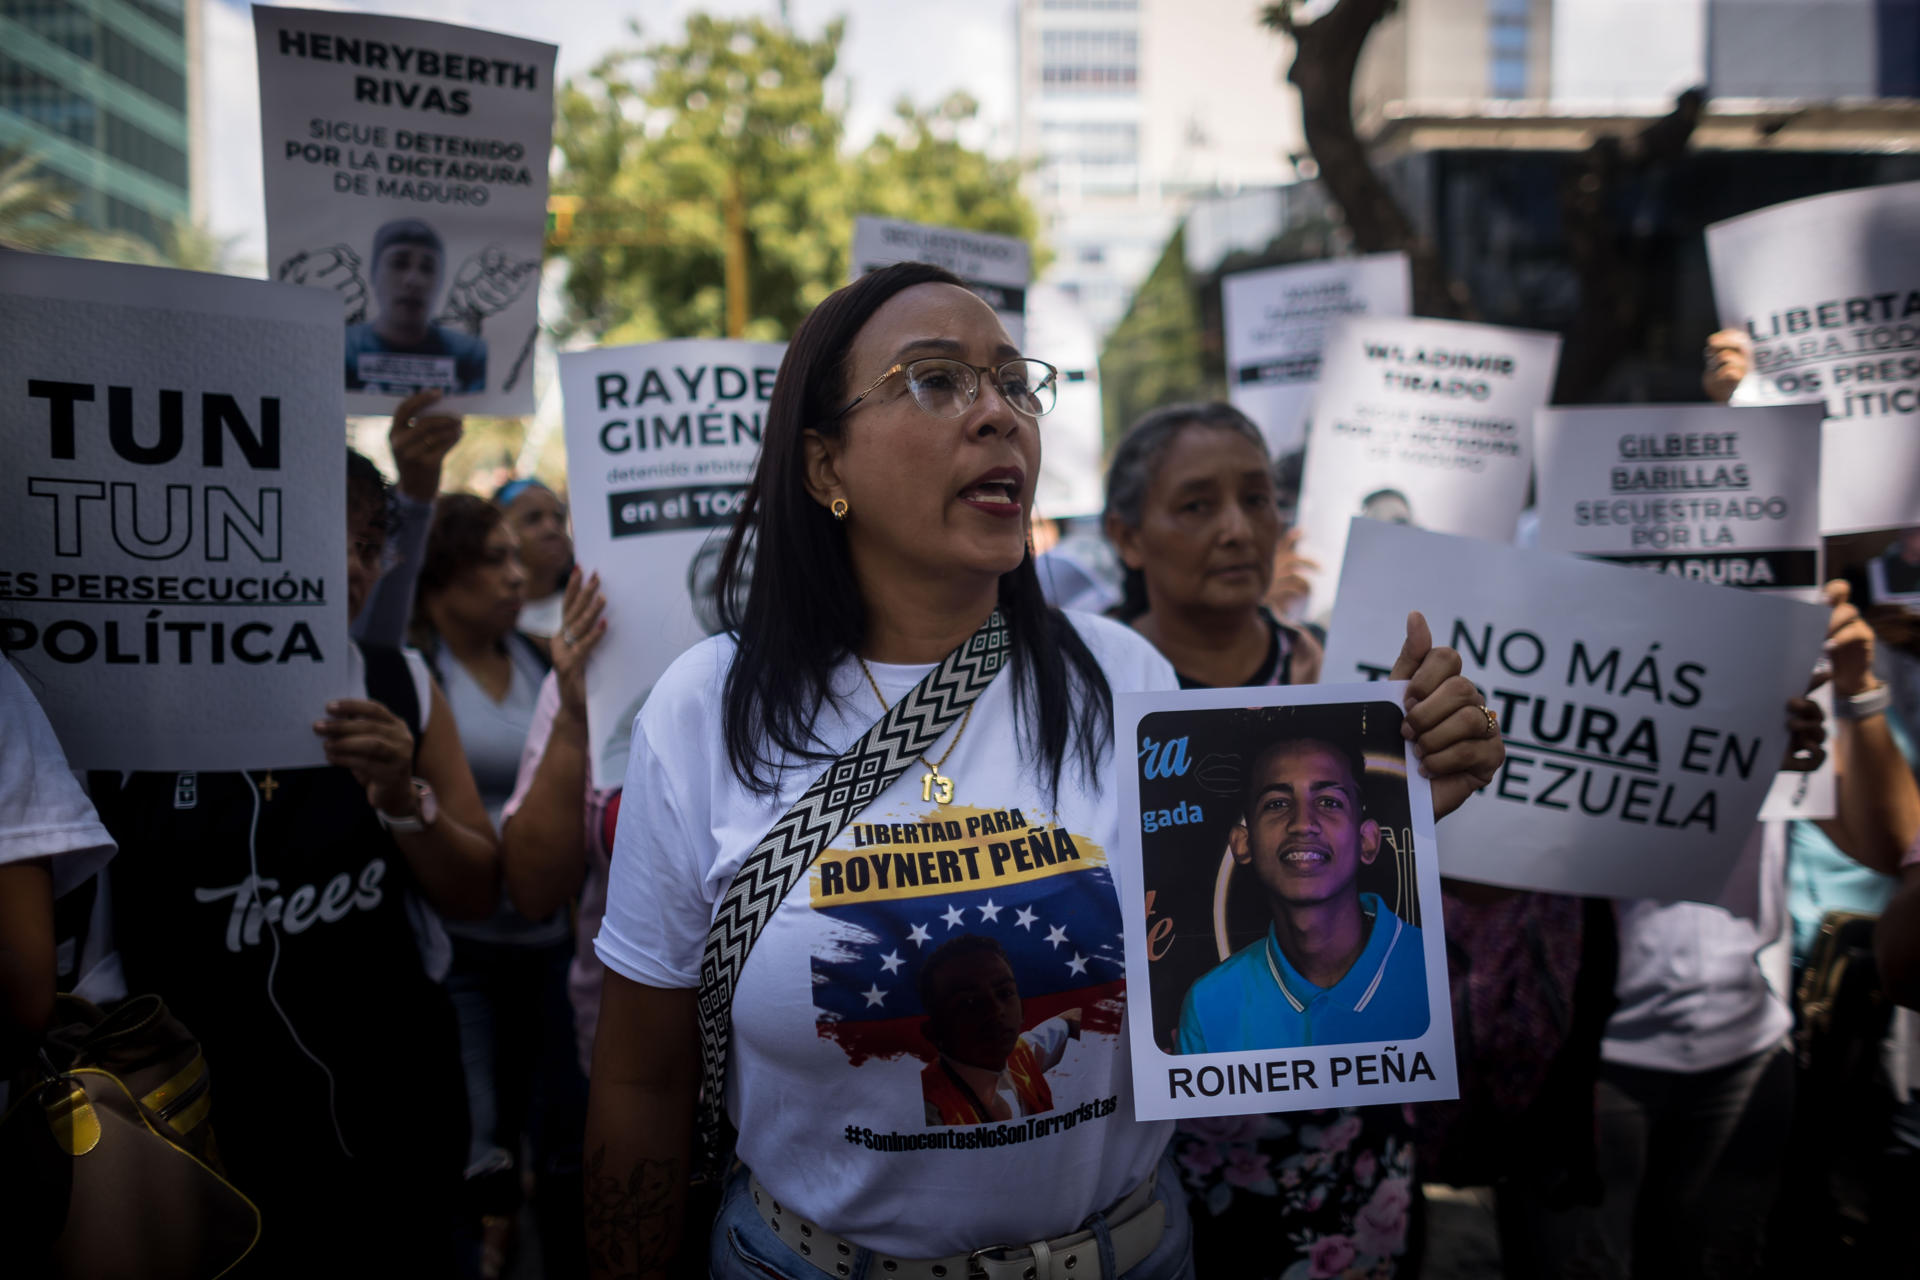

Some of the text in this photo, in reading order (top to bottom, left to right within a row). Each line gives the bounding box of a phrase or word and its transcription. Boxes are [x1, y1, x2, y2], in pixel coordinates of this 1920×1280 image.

[278, 28, 538, 92] HENRYBERTH
[354, 74, 472, 117] RIVAS
[309, 118, 525, 163] SIGUE DETENIDO
[284, 140, 533, 187] POR LA DICTADURA
[333, 171, 490, 207] DE MADURO
[28, 379, 281, 471] TUN
[1618, 432, 1739, 459] GILBERT
[607, 460, 689, 483] detenido
[1610, 464, 1750, 491] BARILLAS
[27, 476, 282, 563] TUN
[621, 501, 657, 523] en
[662, 493, 690, 518] el
[1574, 496, 1788, 527] SECUESTRADO
[1631, 525, 1735, 549] POR LA
[51, 571, 325, 602] PERSECUCIÓN
[0, 608, 325, 664] POLÍTICA
[1451, 616, 1707, 708] NO MÁS
[1680, 726, 1762, 780] EN
[920, 774, 953, 804] 13
[853, 808, 1028, 849] LIBERTAD PARA
[1143, 801, 1204, 833] gada
[820, 826, 1081, 897] ROYNERT PEÑA
[1168, 1045, 1437, 1099] ROINER PEÑA
[844, 1096, 1118, 1152] #SonInocentesNoSonTerroristas
